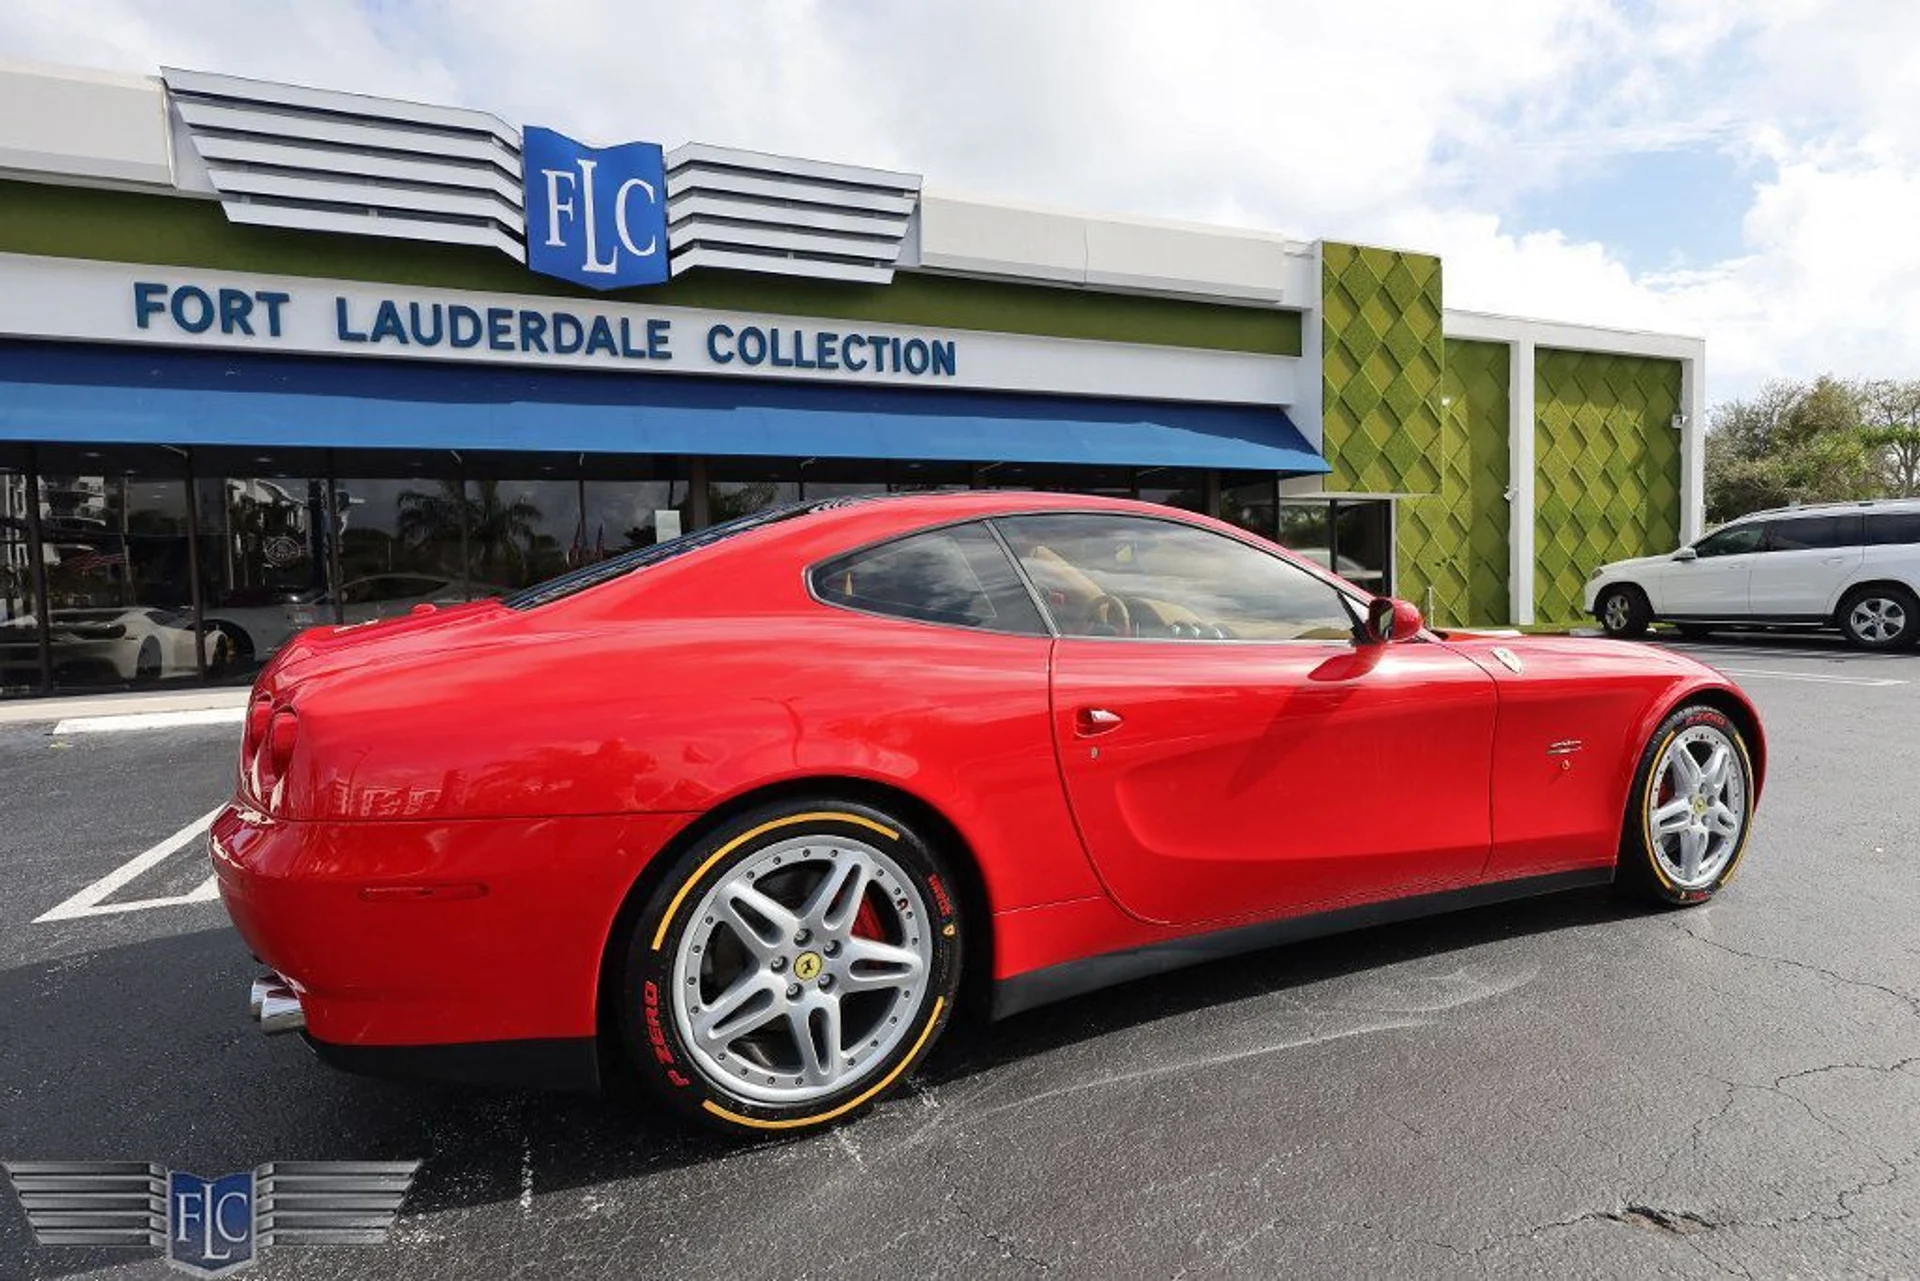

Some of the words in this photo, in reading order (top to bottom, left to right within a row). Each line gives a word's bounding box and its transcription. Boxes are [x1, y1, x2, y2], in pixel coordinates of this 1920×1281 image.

[541, 159, 656, 274] FLC
[134, 282, 290, 337] FORT
[335, 297, 672, 360] LAUDERDALE
[707, 324, 956, 376] COLLECTION
[643, 980, 675, 1065] ZERO
[668, 1068, 689, 1087] P
